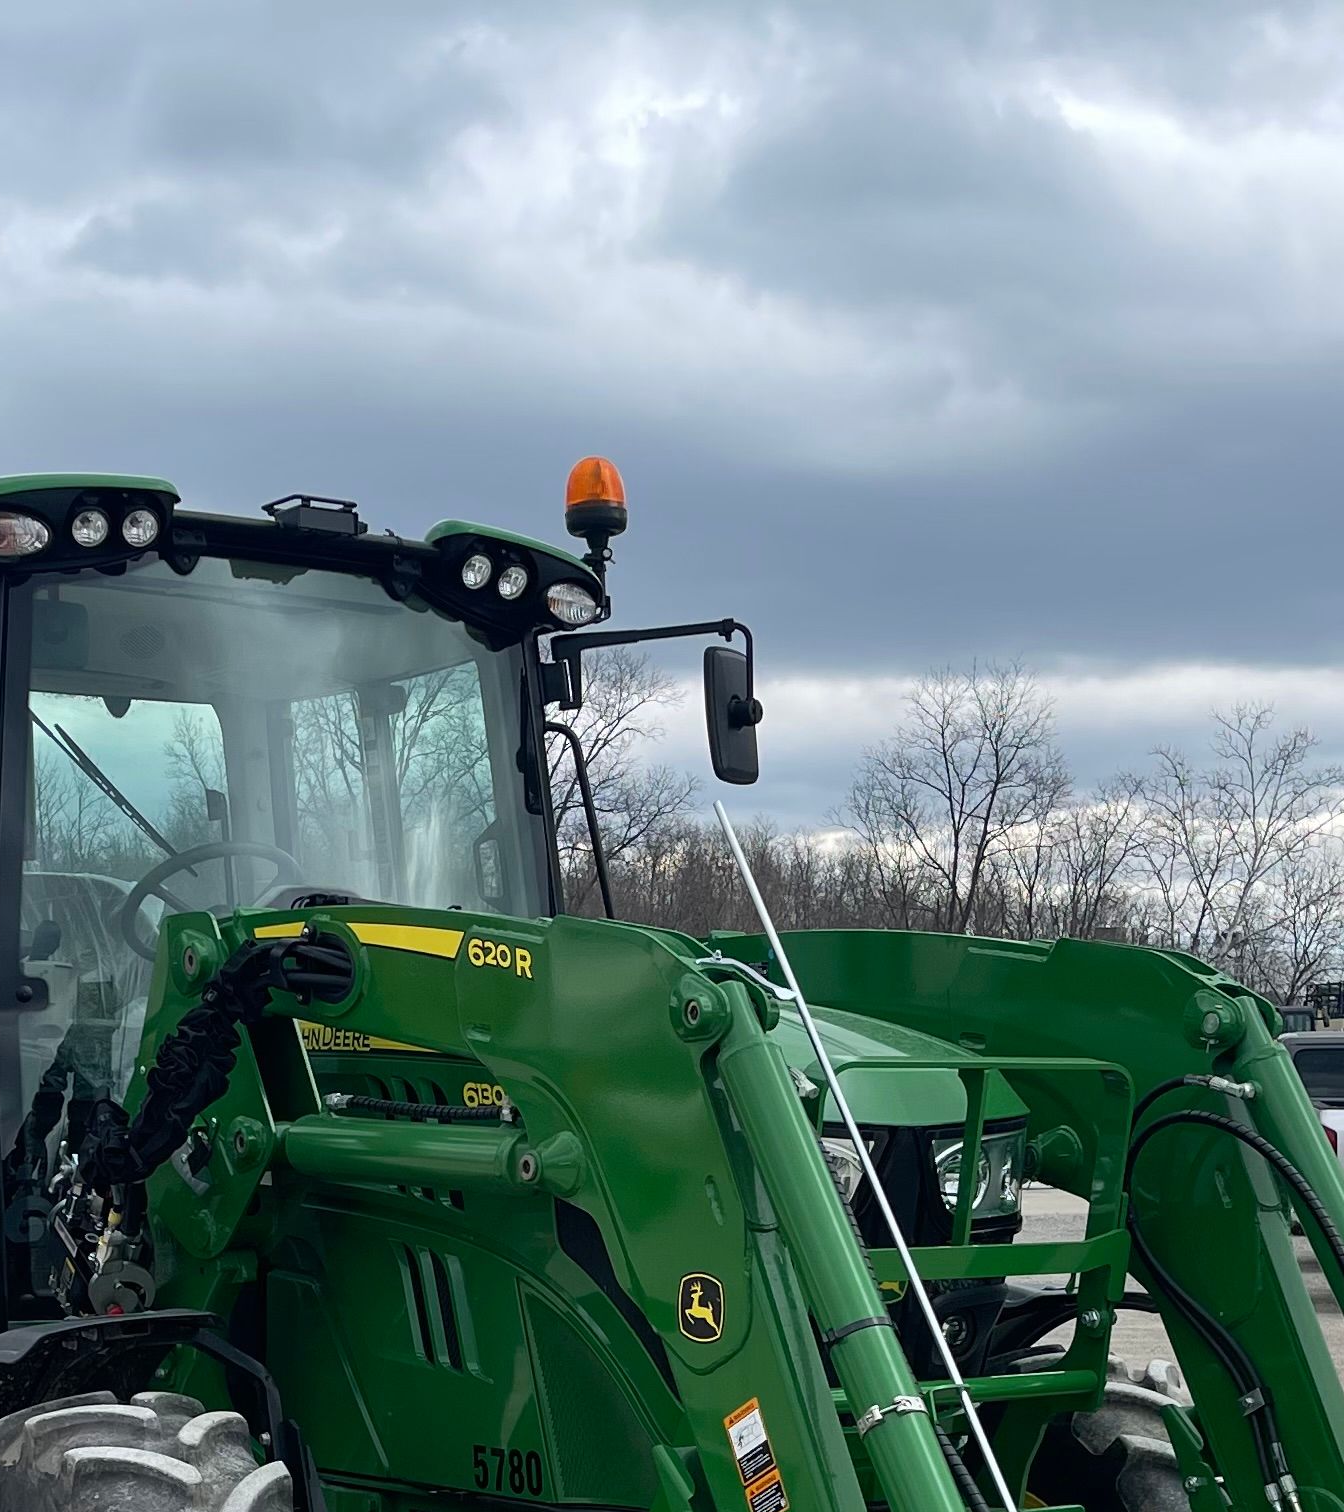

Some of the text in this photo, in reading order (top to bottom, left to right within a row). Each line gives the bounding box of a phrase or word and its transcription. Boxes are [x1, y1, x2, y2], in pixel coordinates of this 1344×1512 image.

[467, 938, 511, 968] 620
[323, 1028, 371, 1051] DEERE
[473, 1444, 543, 1497] 5780
